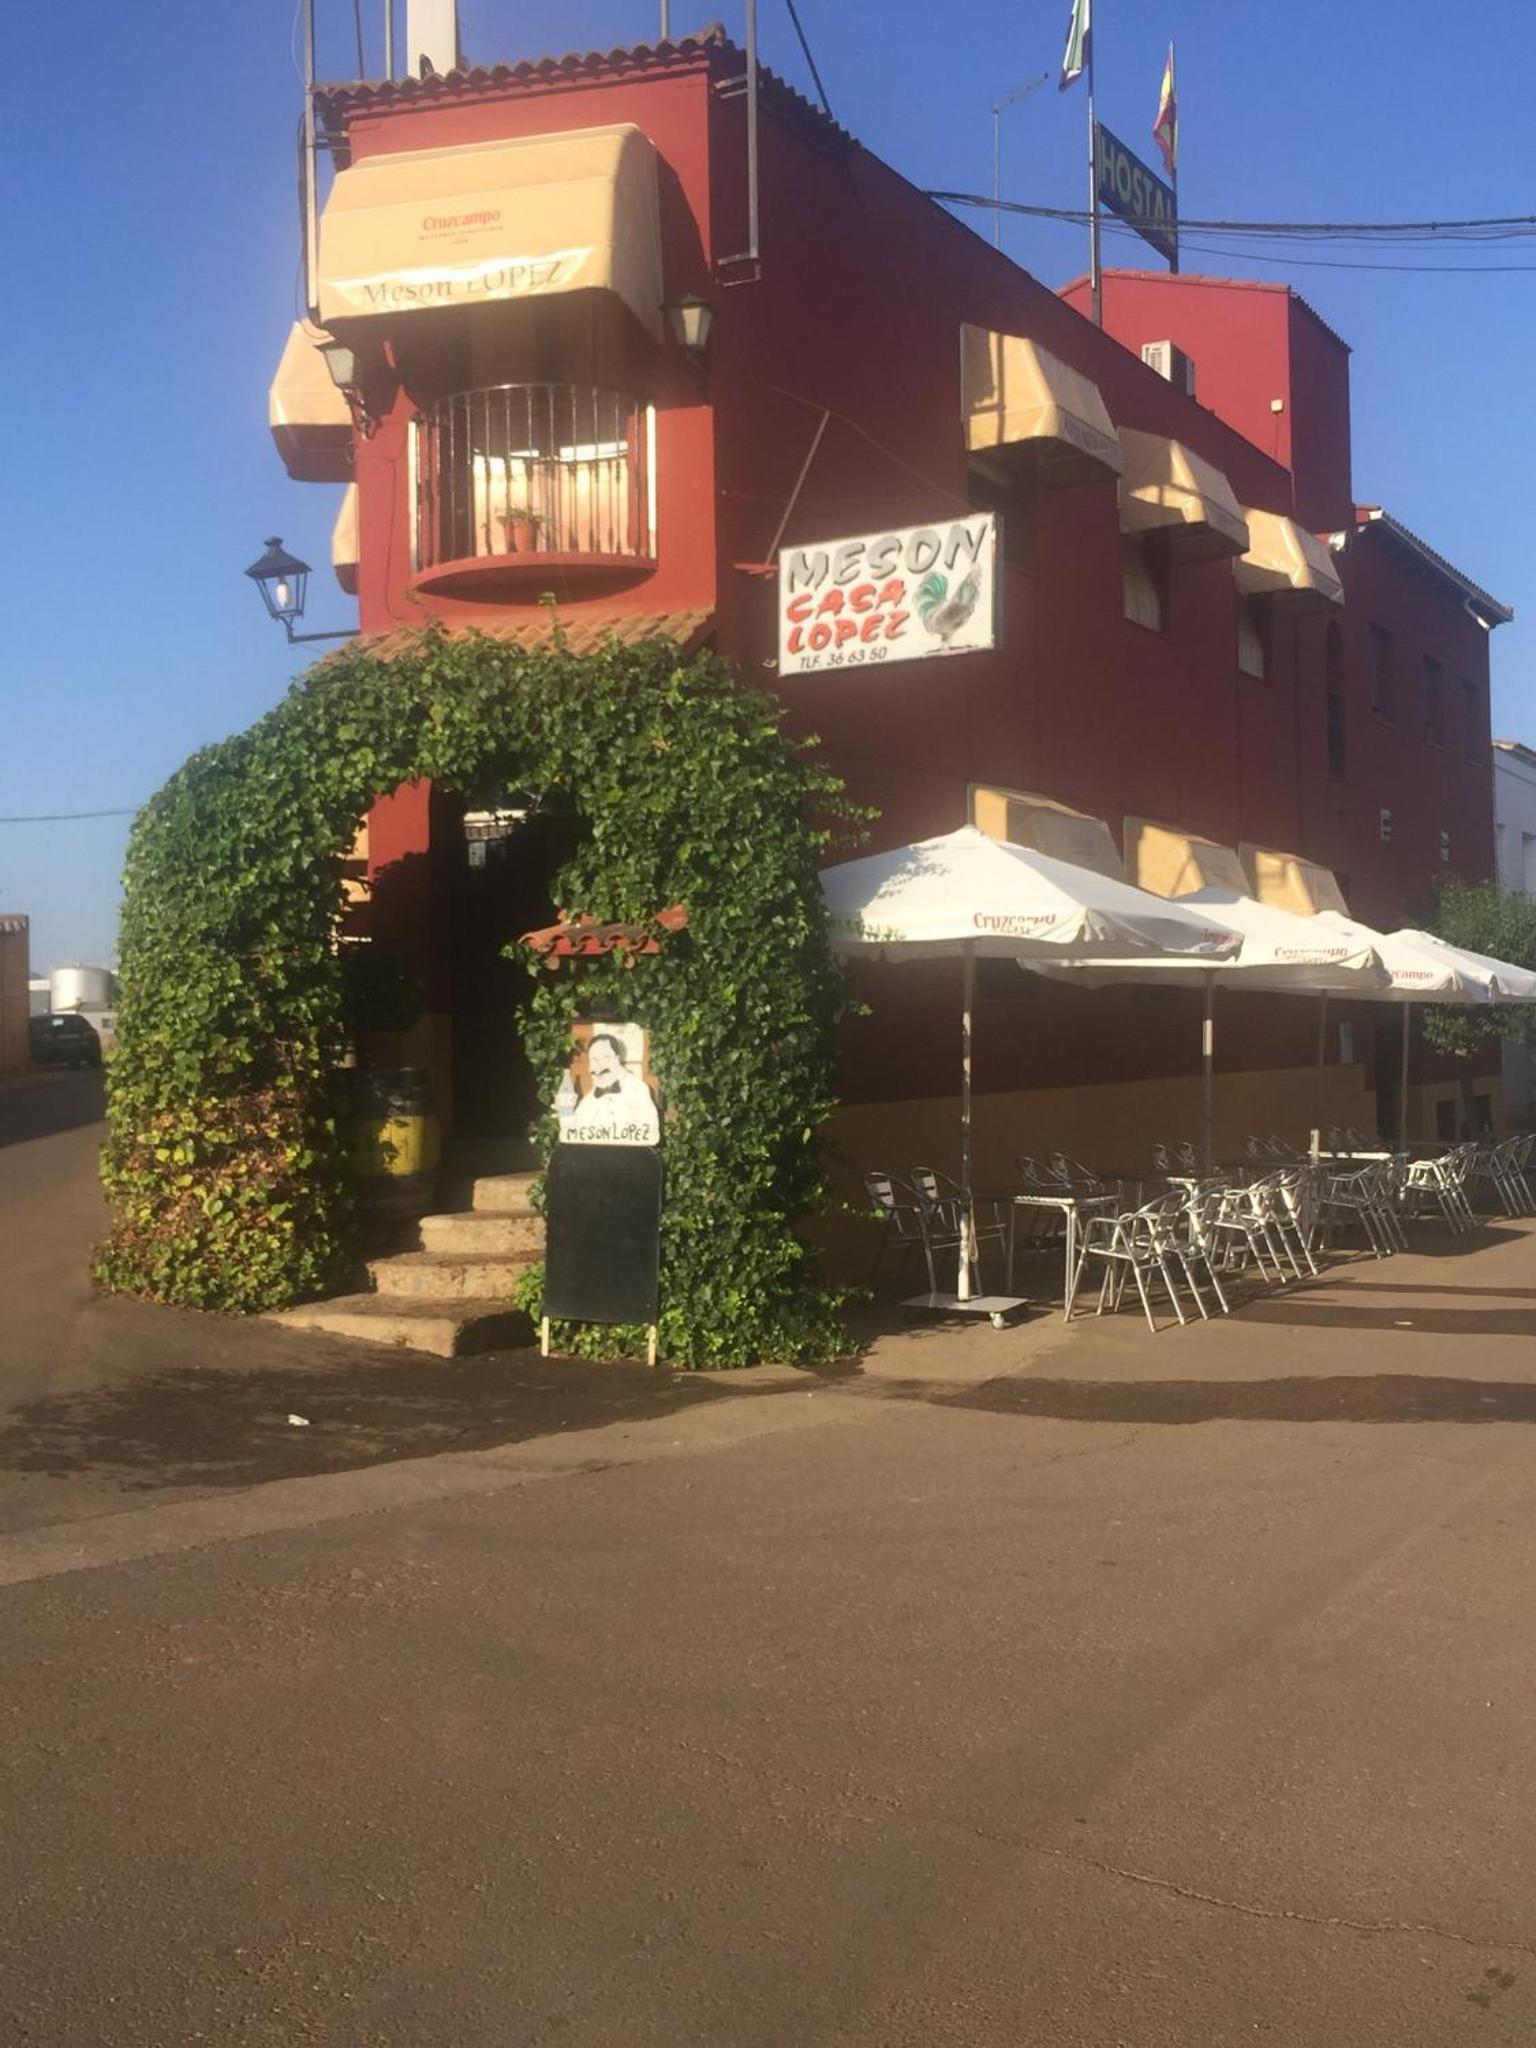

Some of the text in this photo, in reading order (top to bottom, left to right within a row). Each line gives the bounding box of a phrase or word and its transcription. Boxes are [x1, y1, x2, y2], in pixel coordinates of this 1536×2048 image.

[1101, 135, 1177, 243] HOSTAL
[422, 208, 500, 231] Cruzcampo
[788, 522, 989, 594] MESON
[786, 577, 907, 623] CASA
[786, 610, 911, 656] LOPEZ
[827, 652, 844, 666] 36
[848, 649, 865, 664] 63
[869, 646, 888, 661] 50
[566, 1122, 651, 1142] MESON LOPEZ
